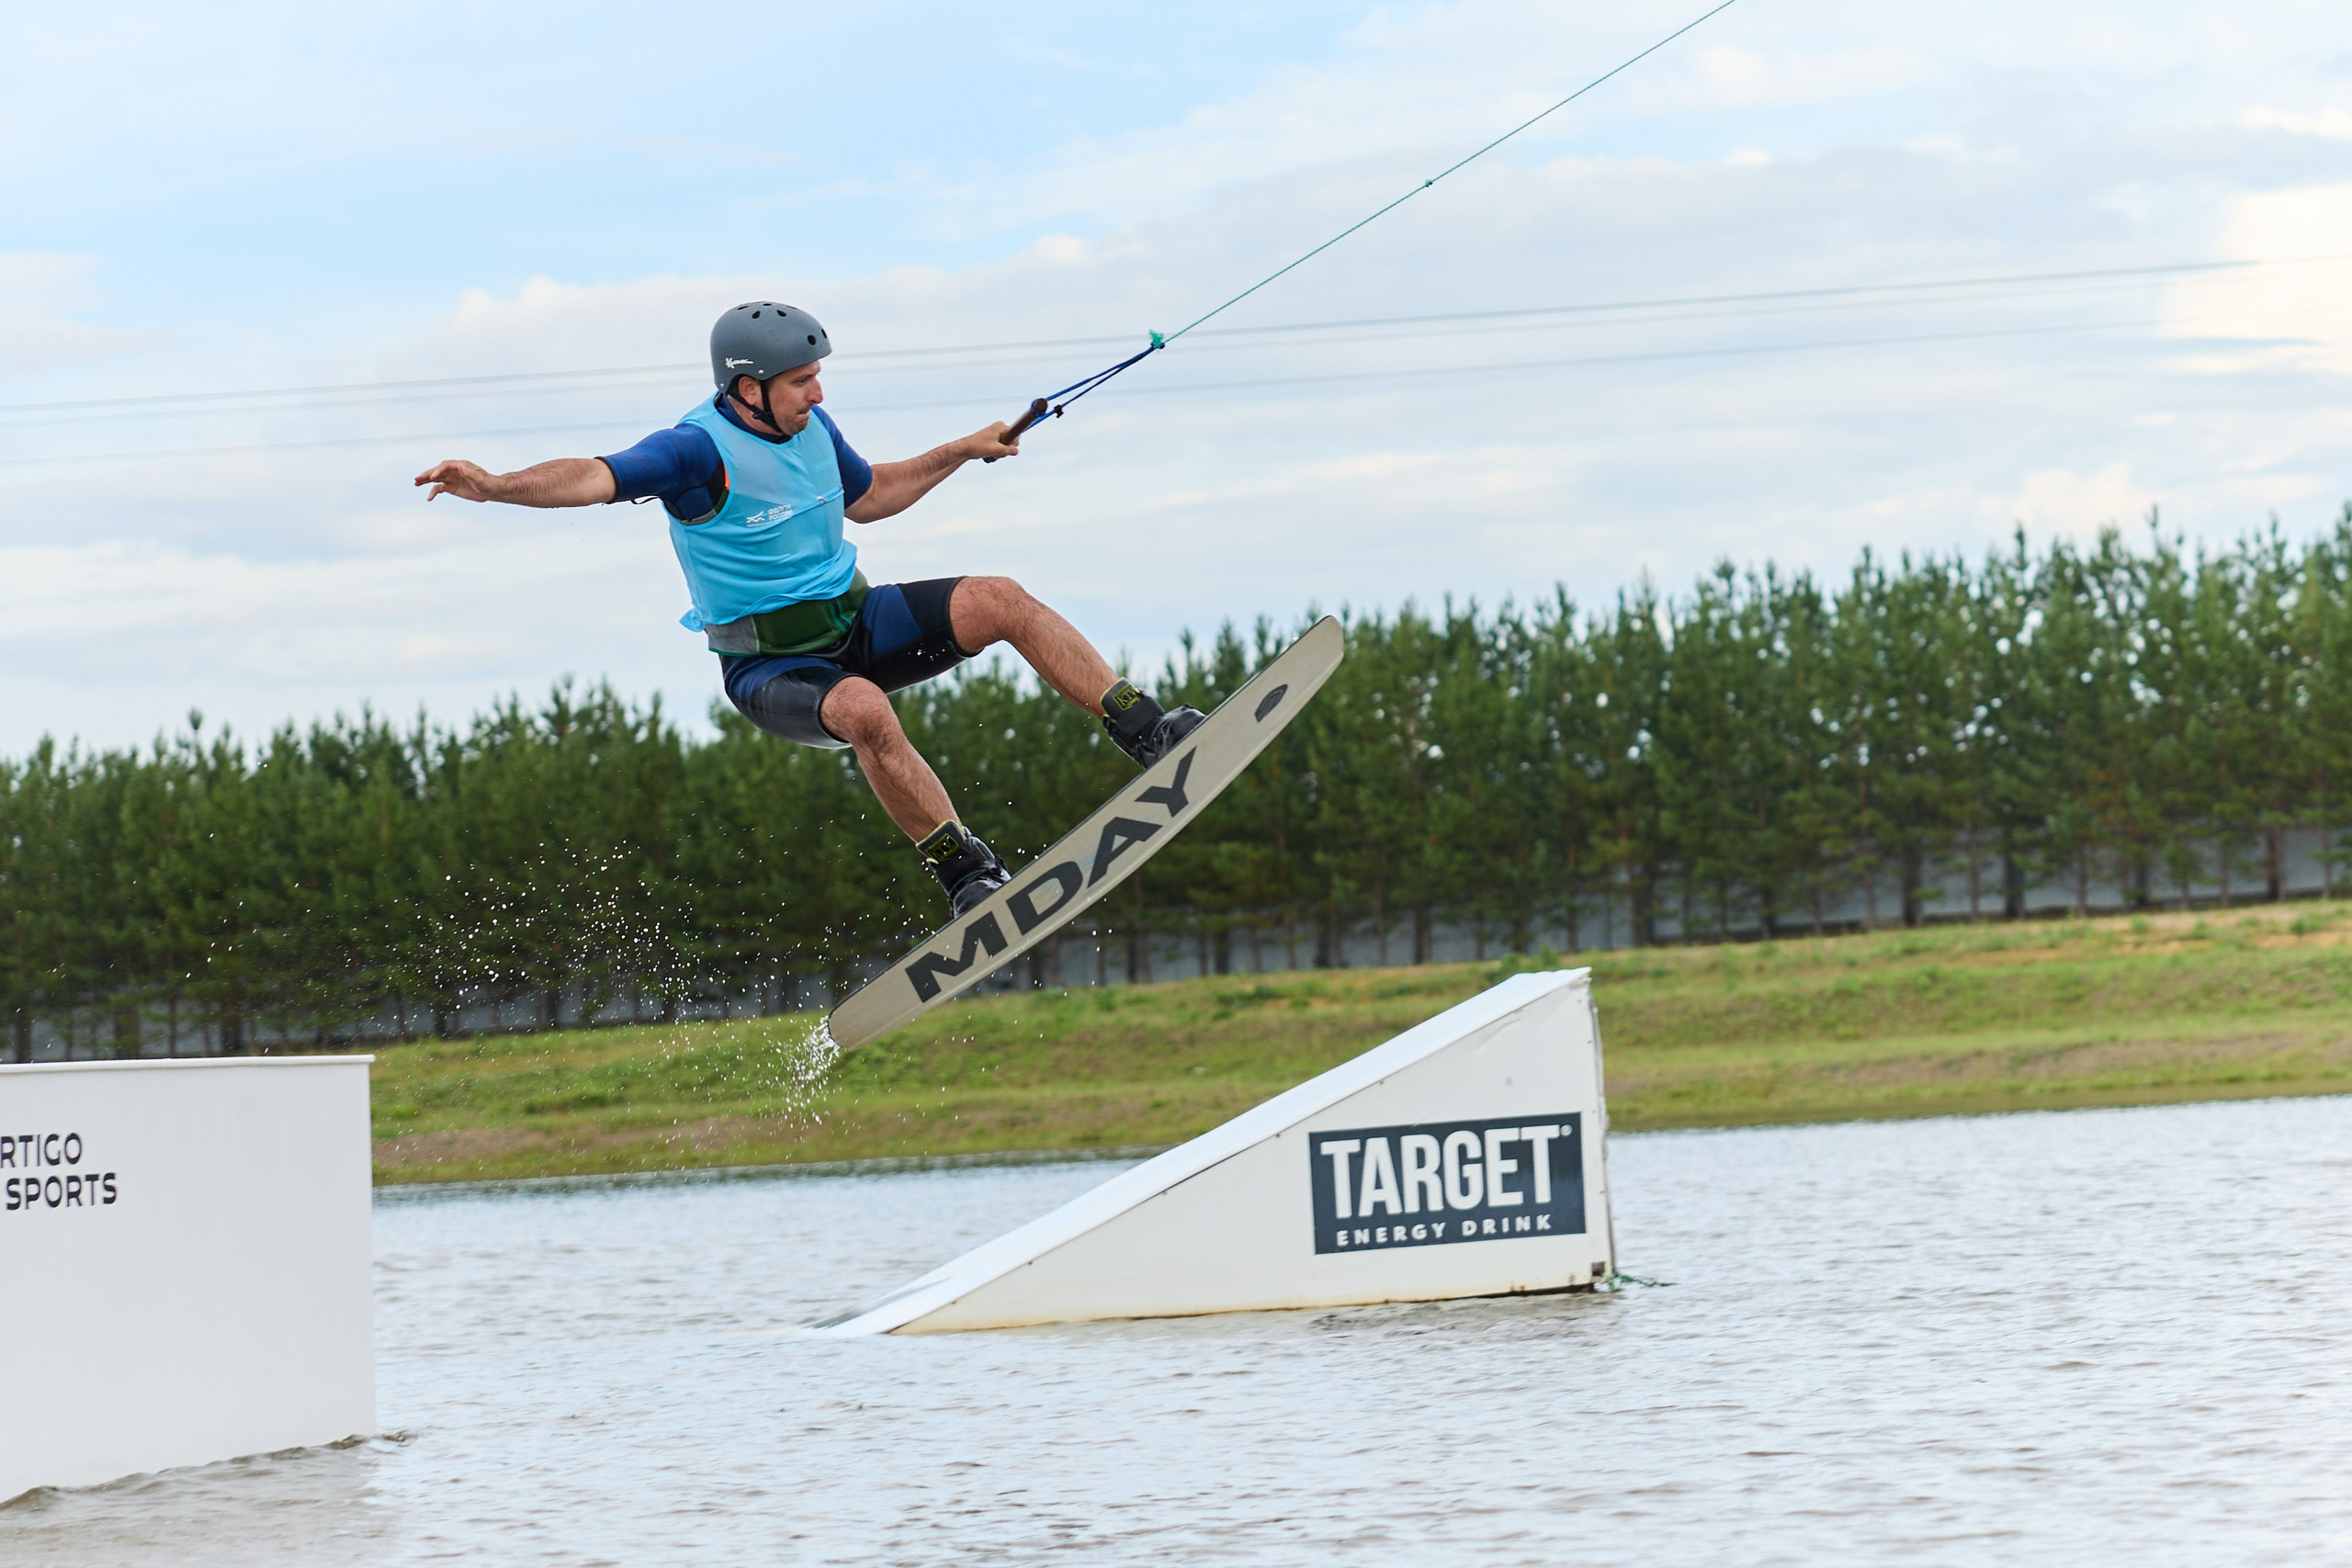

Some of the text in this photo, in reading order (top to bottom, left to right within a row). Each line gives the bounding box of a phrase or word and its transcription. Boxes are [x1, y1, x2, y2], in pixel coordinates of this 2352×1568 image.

[905, 746, 1197, 1003] MDAY
[0, 1132, 83, 1168] RTIGO
[6, 1172, 117, 1211] SPORTS
[1336, 1213, 1552, 1247] ENERGY DRINK
